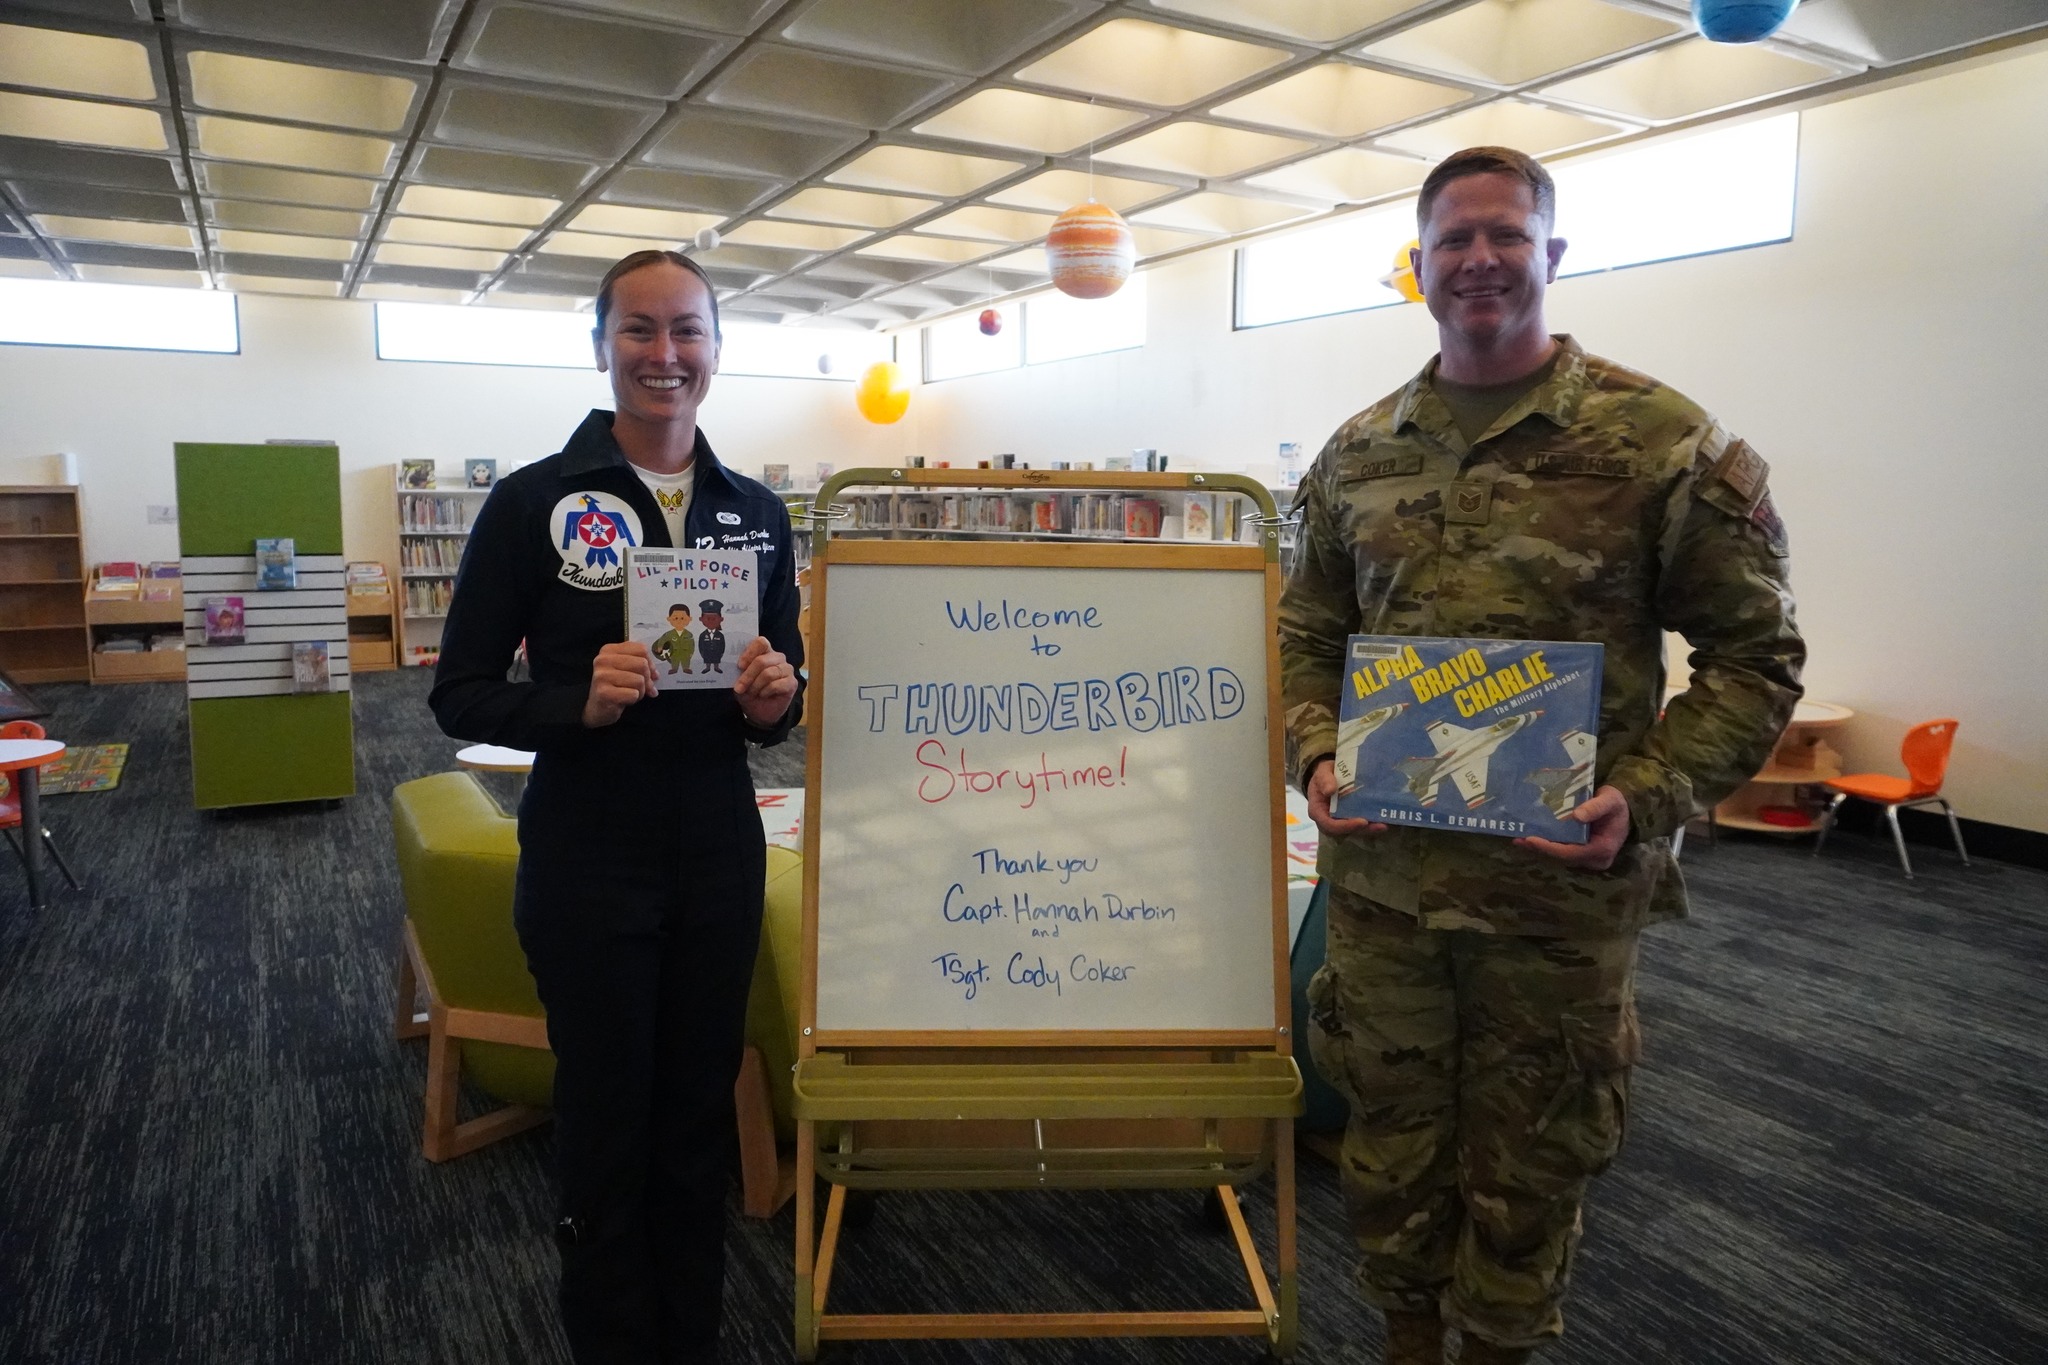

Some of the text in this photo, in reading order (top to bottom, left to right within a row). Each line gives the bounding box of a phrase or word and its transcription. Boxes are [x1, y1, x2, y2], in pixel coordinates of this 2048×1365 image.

[1360, 458, 1396, 477] COKER
[1588, 457, 1631, 476] FORCE
[696, 536, 715, 550] 12
[562, 562, 623, 588] Thunderb
[674, 577, 718, 590] PILOT
[700, 559, 750, 582] FORCE
[945, 599, 1103, 632] Welcome
[1030, 634, 1061, 656] to
[1352, 644, 1425, 700] ALPHA
[1409, 648, 1487, 704] BRAVO
[1453, 650, 1555, 718] CHARLIE
[858, 666, 1245, 735] THUNDERBIRD
[1493, 670, 1580, 716] The Military Alphabet
[916, 739, 1128, 809] Storytime!
[1336, 760, 1351, 778] USAF
[1465, 770, 1481, 790] USAF
[1379, 808, 1526, 833] CHRIS L. DEMAREST
[972, 848, 1099, 884] Thank you
[943, 883, 1176, 924] Capt. Hannah Durbin
[1031, 924, 1060, 938] and
[931, 952, 1136, 1000] TSgt. Cody Coker
